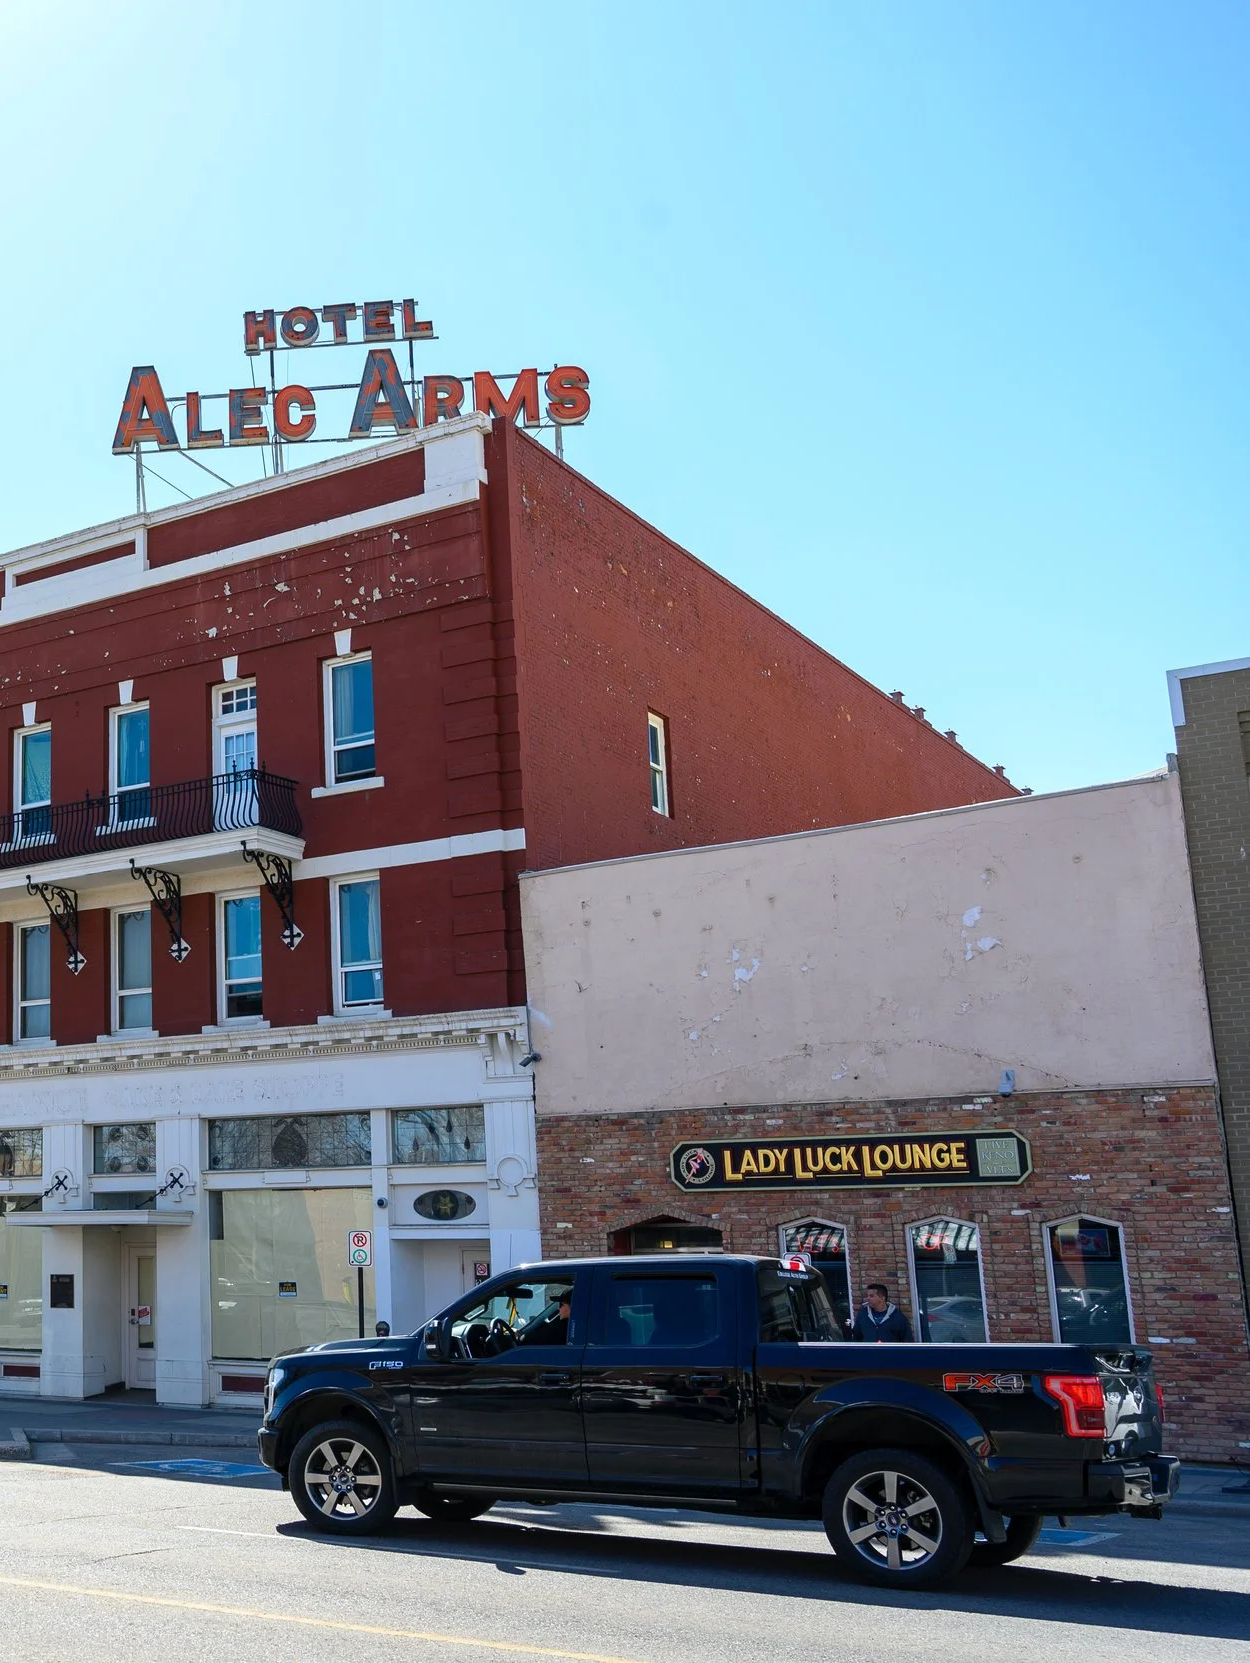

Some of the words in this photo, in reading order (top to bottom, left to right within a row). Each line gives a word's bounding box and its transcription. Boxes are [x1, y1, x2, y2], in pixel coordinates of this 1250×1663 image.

[244, 298, 434, 355] HOTEL
[112, 365, 317, 454] ALEC
[349, 348, 591, 438] ARMS
[982, 1150, 1014, 1161] KENO
[984, 1140, 1011, 1149] LIVE
[723, 1148, 788, 1181] LADY
[794, 1145, 859, 1179] LUCK
[862, 1142, 969, 1178] LOUNGE
[942, 1372, 1025, 1392] FX4
